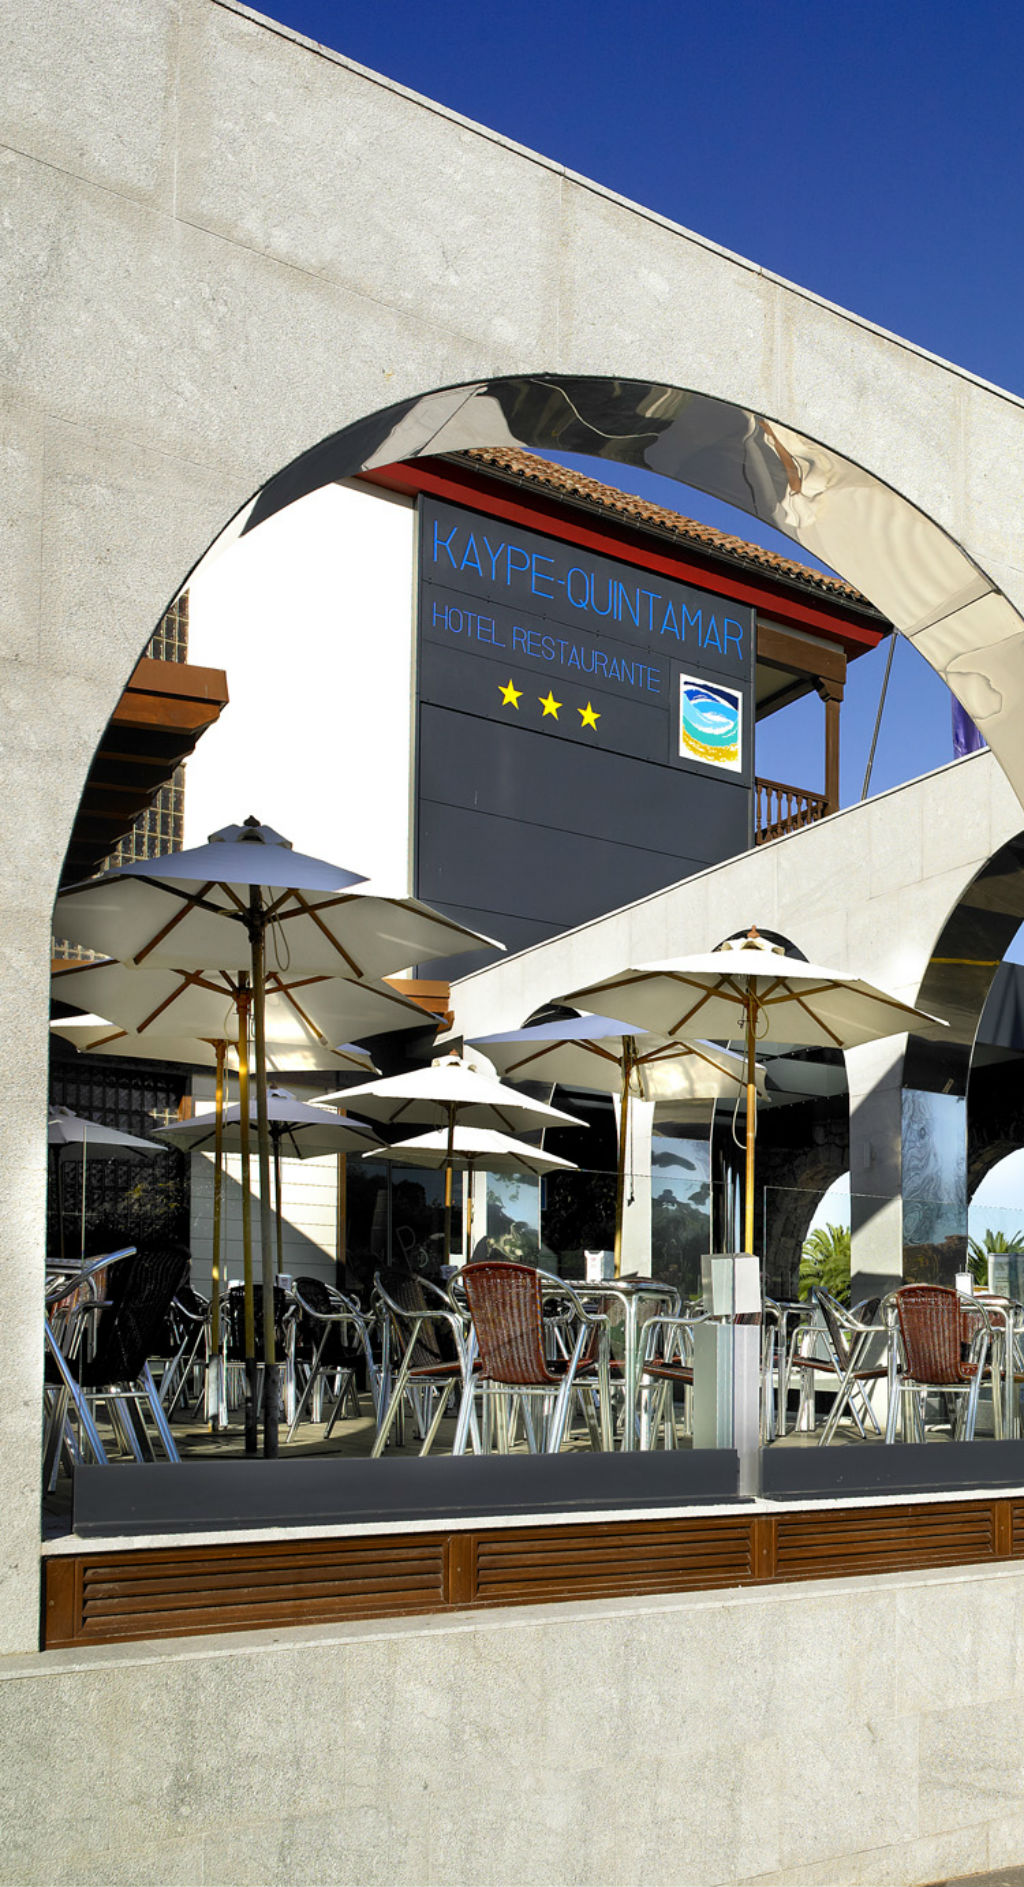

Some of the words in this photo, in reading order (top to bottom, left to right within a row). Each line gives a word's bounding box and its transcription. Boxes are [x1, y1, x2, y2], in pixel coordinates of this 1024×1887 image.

[432, 602, 506, 648] HOTEL
[512, 625, 661, 693] RESTAURANTE
[433, 519, 744, 661] KAYPE-QUINTAMAR
